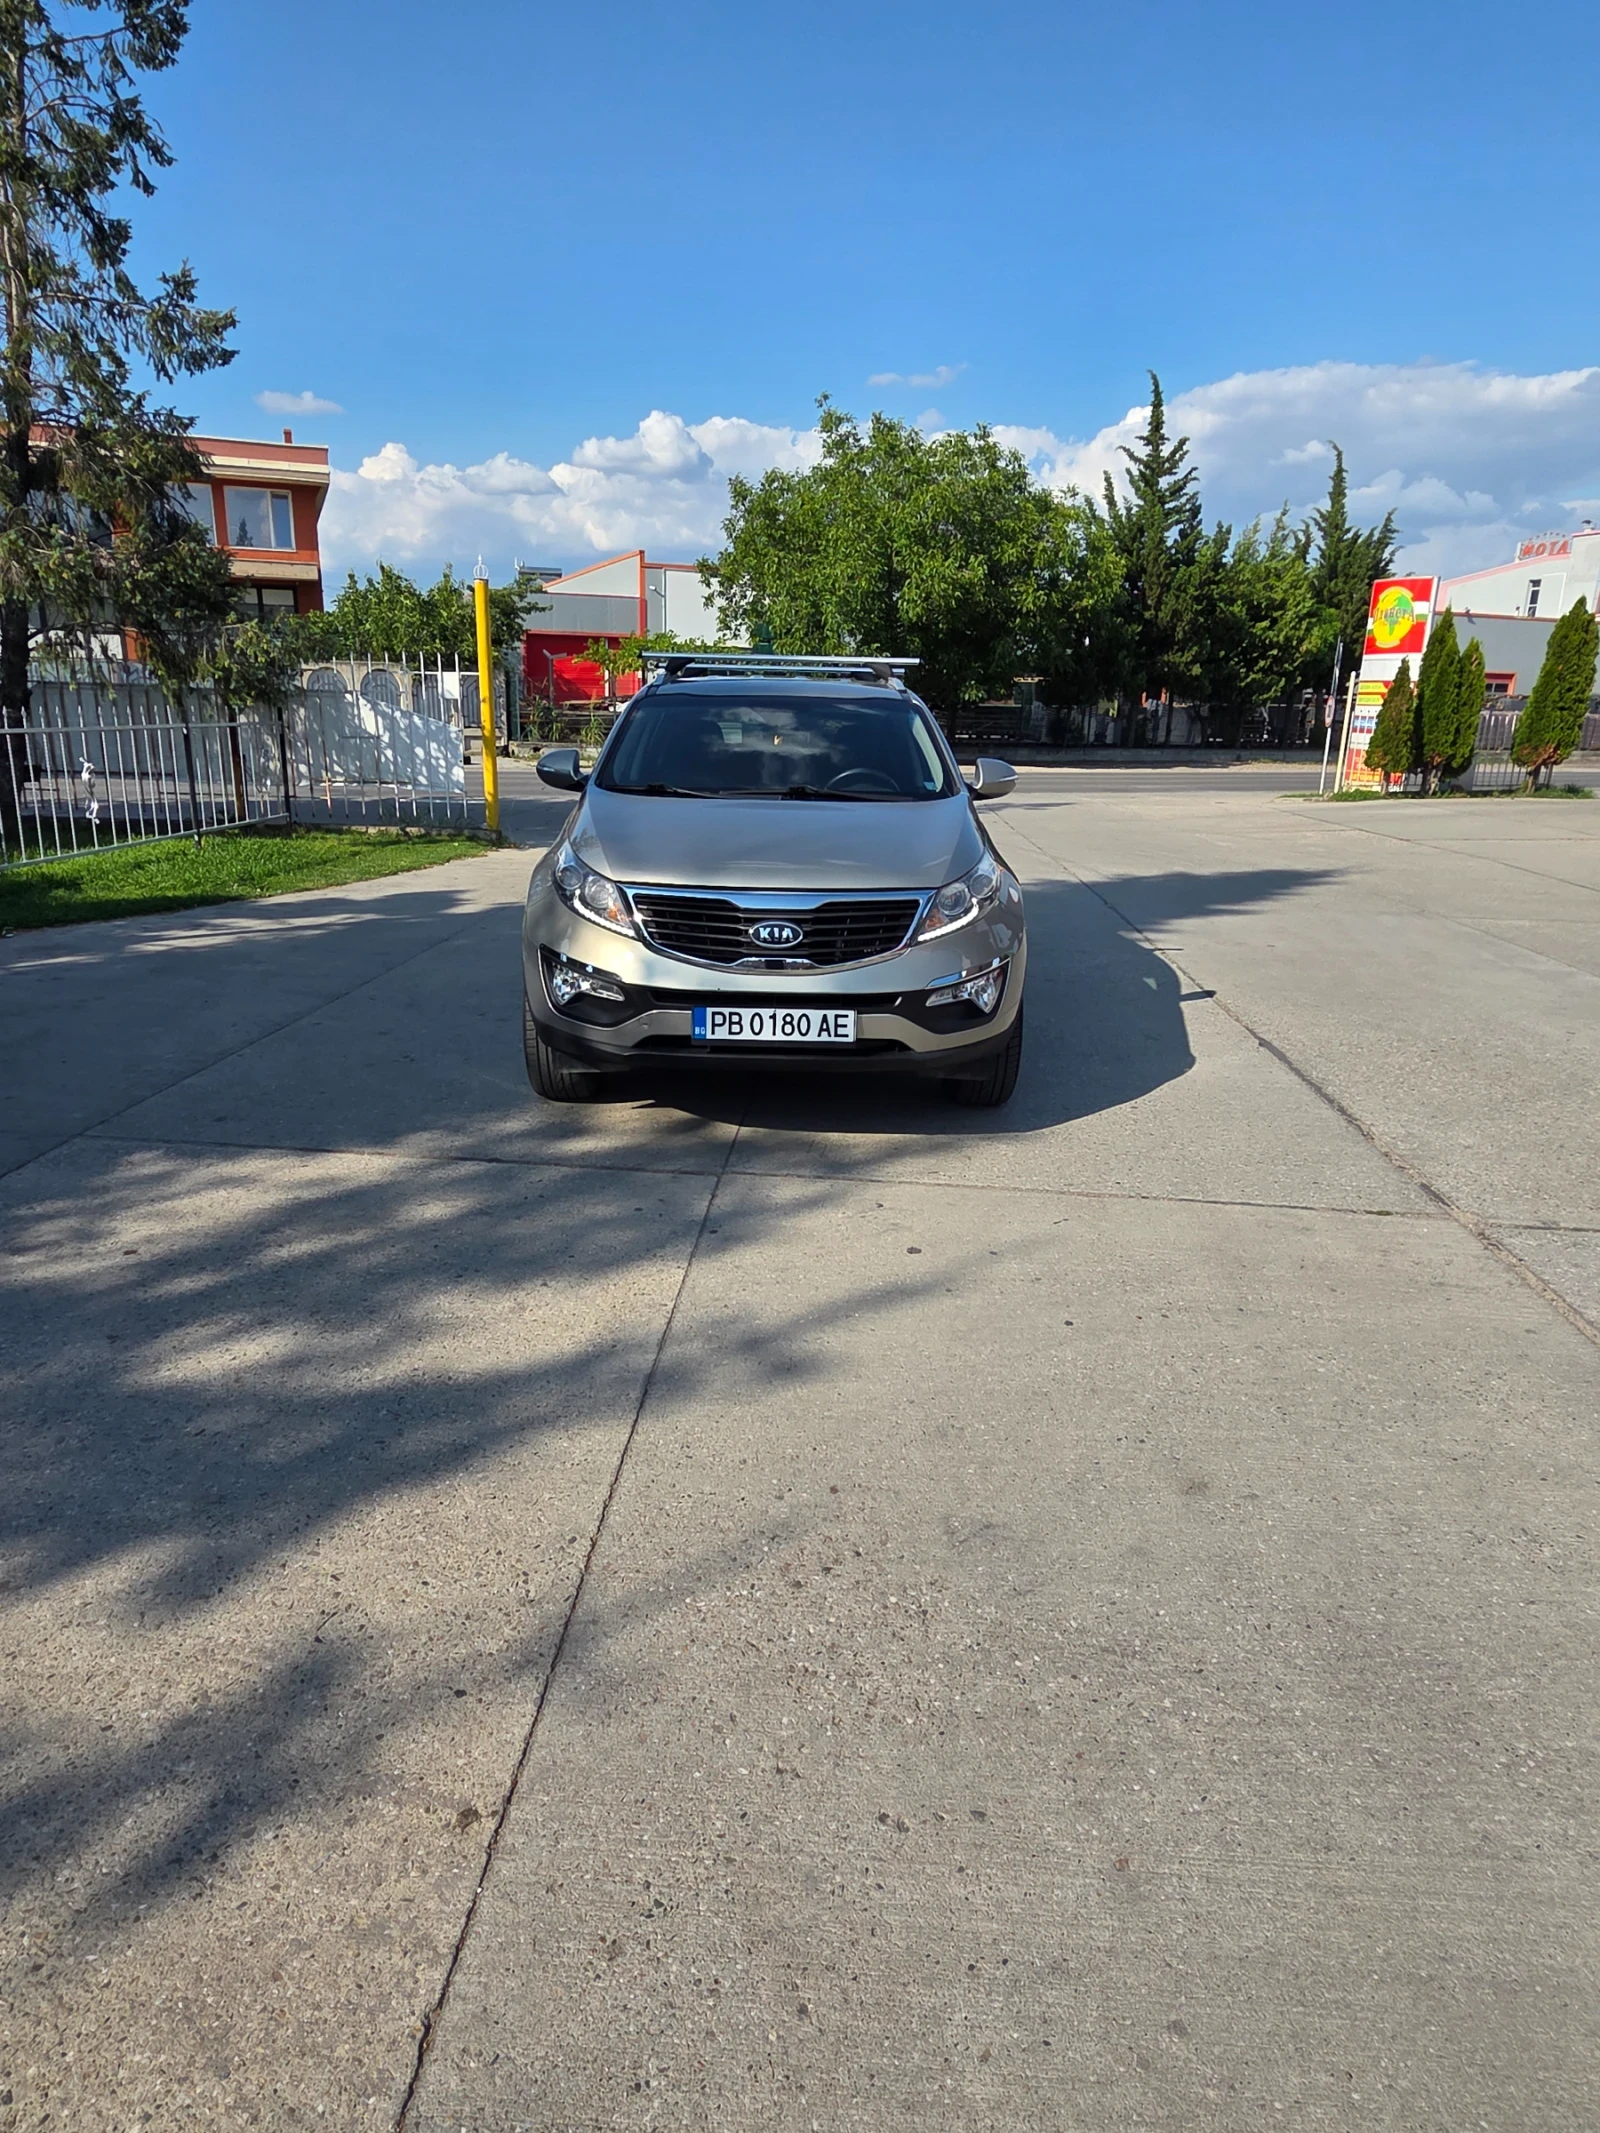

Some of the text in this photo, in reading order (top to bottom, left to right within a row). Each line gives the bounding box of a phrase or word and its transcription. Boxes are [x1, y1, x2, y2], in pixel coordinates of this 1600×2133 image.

[758, 927, 793, 941] KIA
[694, 1026, 706, 1035] BG
[710, 1011, 850, 1038] PB 0180 AE
